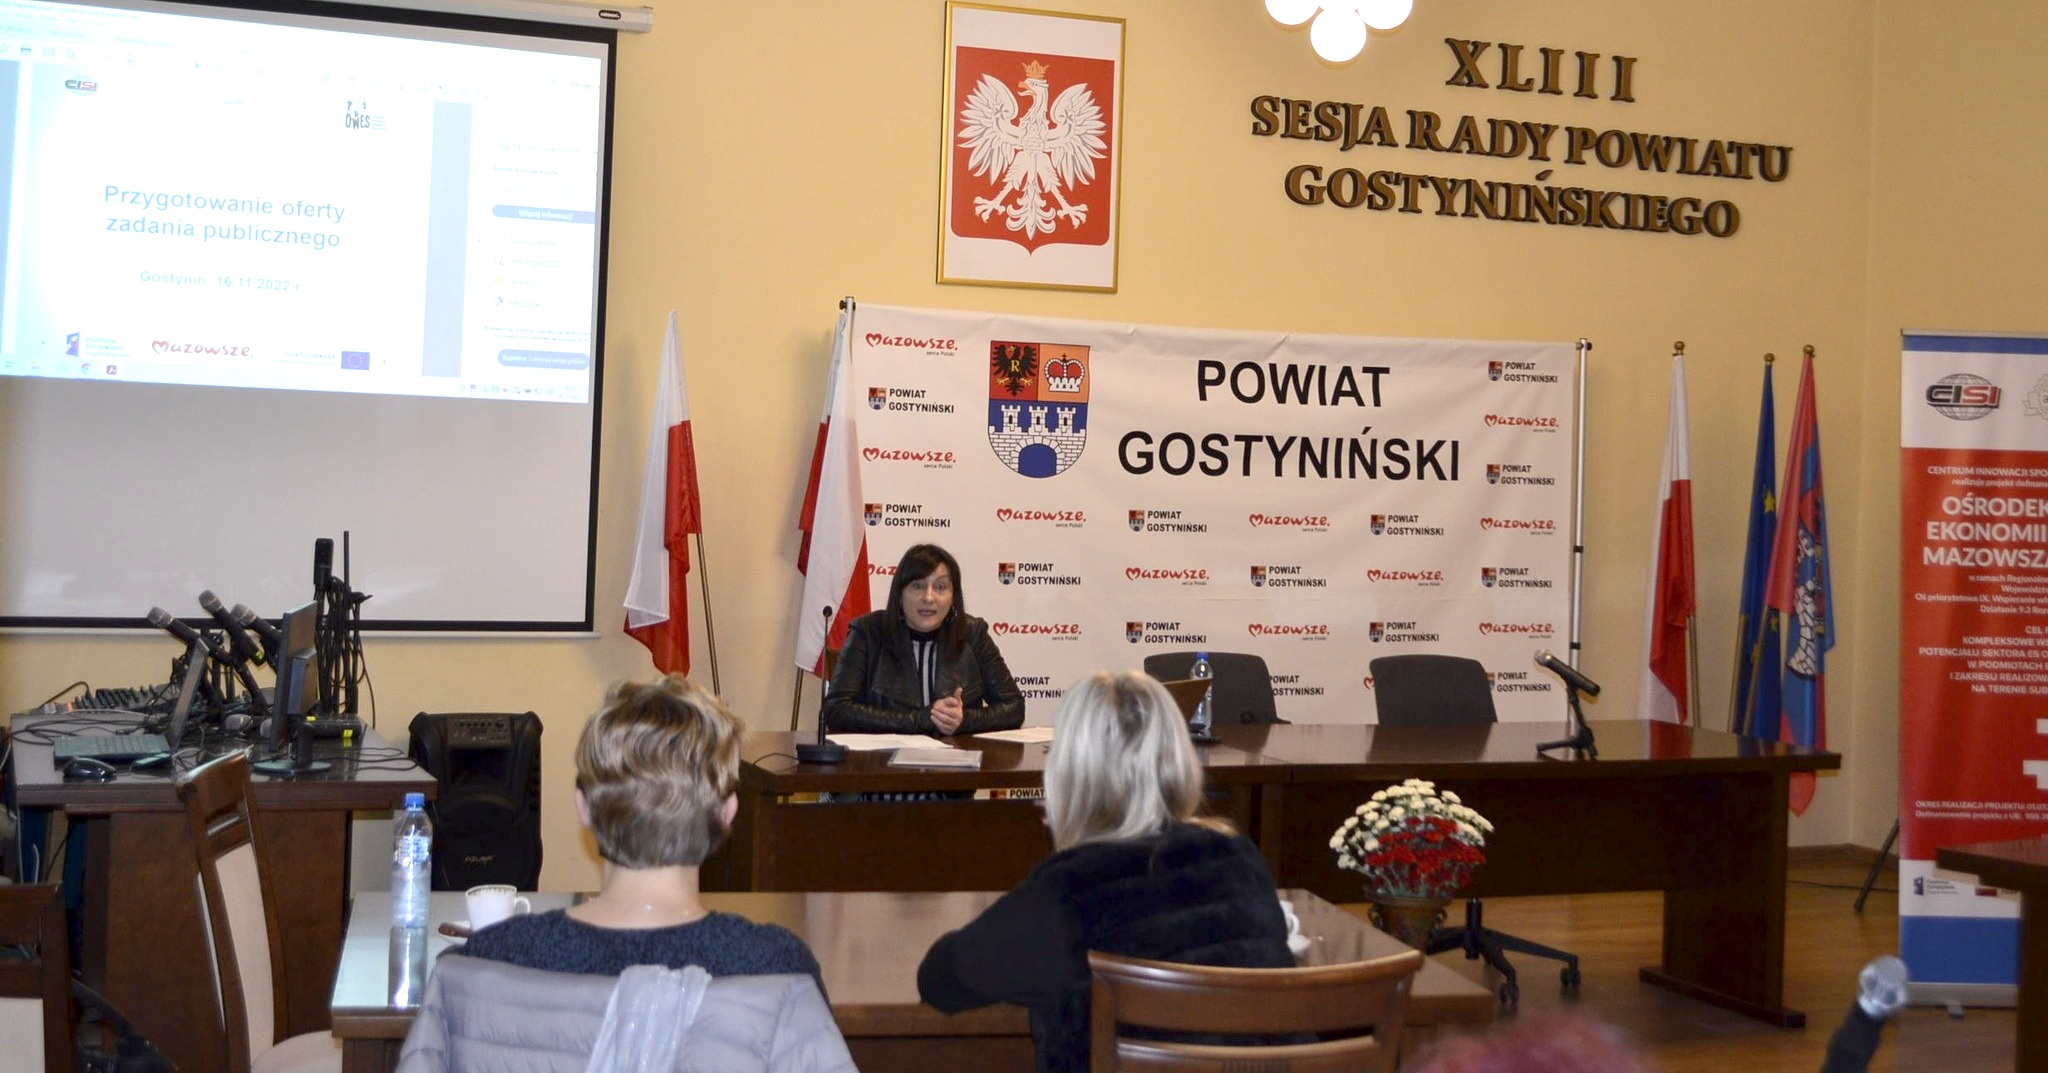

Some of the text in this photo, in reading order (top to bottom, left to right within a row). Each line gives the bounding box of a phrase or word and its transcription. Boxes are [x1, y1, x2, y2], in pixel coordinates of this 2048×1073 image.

[65, 79, 98, 92] CISI
[1250, 95, 1793, 182] SESJA RADY POWIATU
[104, 185, 346, 223] Przygotowanie oferty
[1284, 164, 1741, 238] GOSTYNIŃSKIEGO
[106, 216, 340, 250] zadania publicznego
[1010, 360, 1020, 373] R
[1505, 362, 1536, 371] POWIAT
[1198, 359, 1390, 407] POWIAT
[889, 388, 927, 399] POWIAT
[1926, 384, 2001, 408] CISI
[1118, 426, 1459, 481] GOSTYNIŃSKI
[1502, 464, 1532, 473] POWIAT
[1927, 466, 1974, 475] CENTRUM
[885, 504, 922, 513] POWIAT
[1147, 510, 1182, 520] POWIAT
[1388, 515, 1419, 523] POWIAT
[1926, 521, 2047, 542] EKONOMII
[1018, 563, 1054, 572] POWIAT
[1269, 565, 1301, 575] POWIAT
[1499, 567, 1529, 576] POWIAT
[1145, 622, 1181, 631] POWIAT
[1386, 621, 1416, 630] POWIAT
[1962, 636, 2035, 646] KOMPLEKSOWE
[1982, 648, 2025, 658] SEKTORA
[1967, 660, 1977, 669] W
[1979, 660, 2042, 670] PODMIOTACH
[1497, 671, 1528, 680] POWIAT
[1020, 687, 1065, 699] OSTYNIŃ
[1272, 686, 1324, 696] OSTYNIŃSKI
[1971, 684, 1986, 693] NA
[1988, 684, 2026, 694] TERENIE
[1010, 789, 1045, 798] POWIAT
